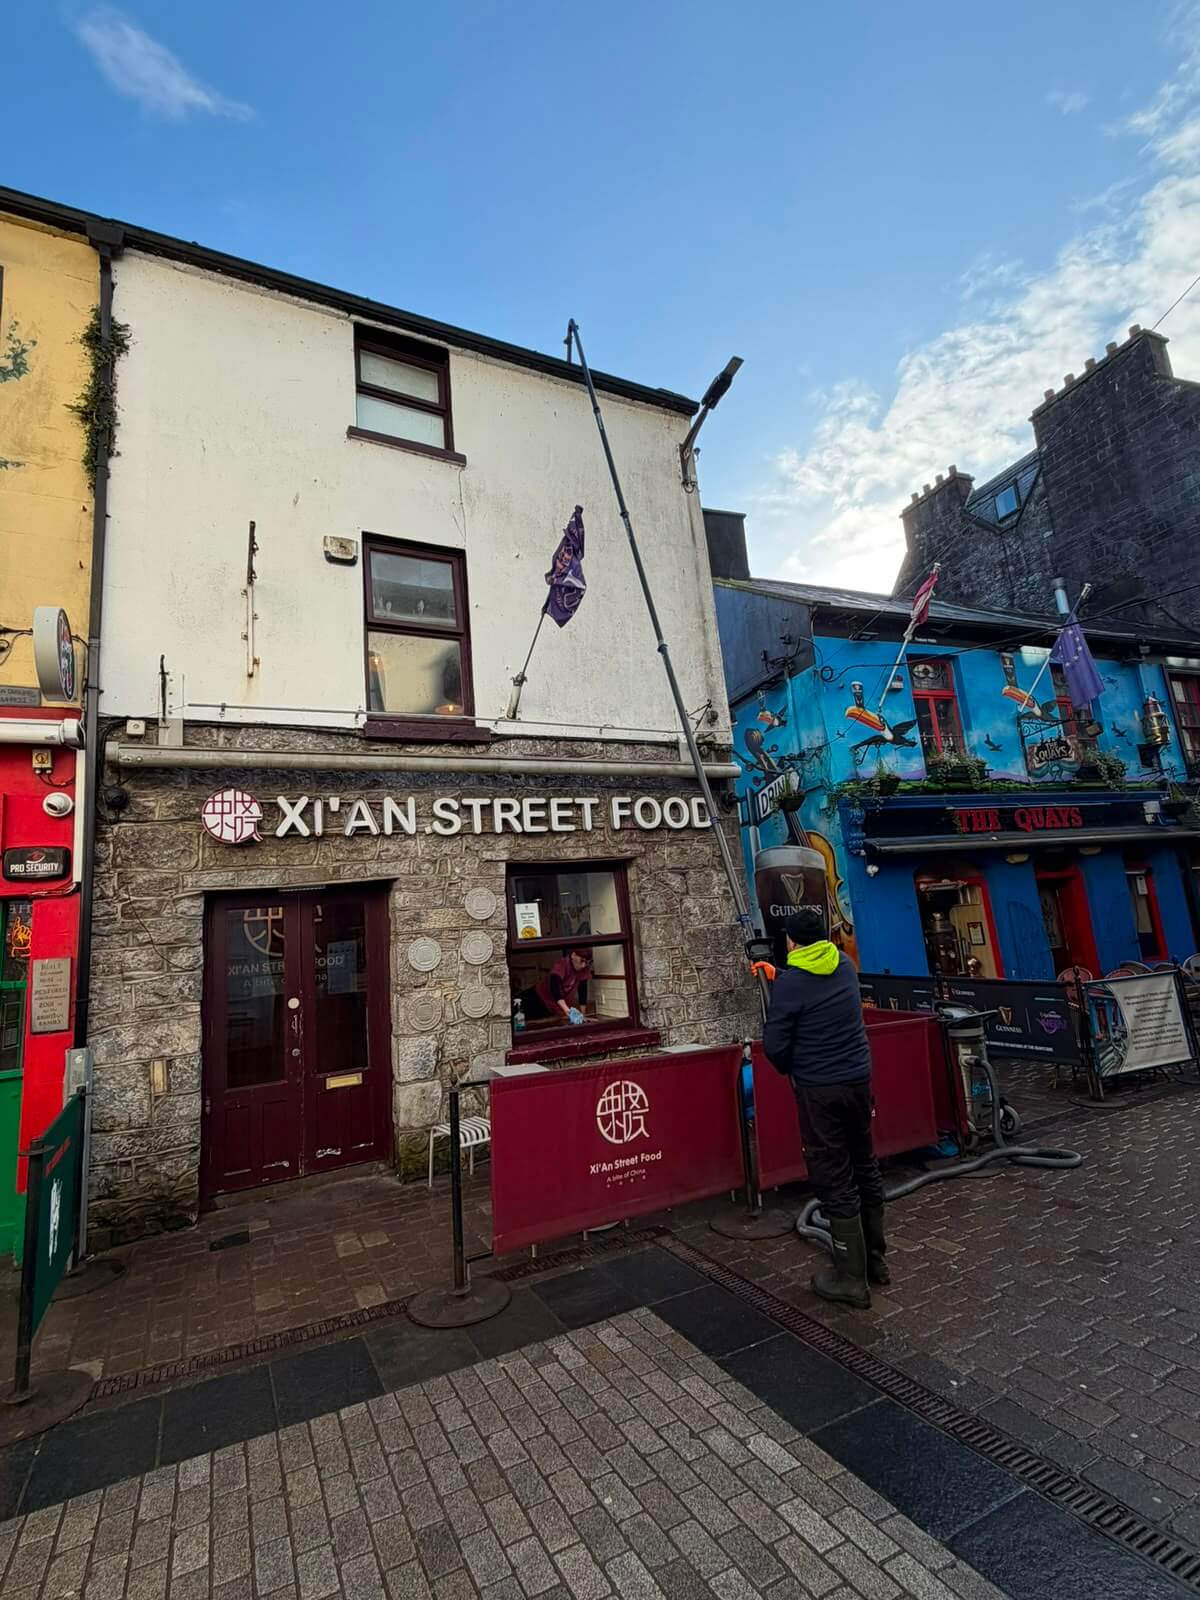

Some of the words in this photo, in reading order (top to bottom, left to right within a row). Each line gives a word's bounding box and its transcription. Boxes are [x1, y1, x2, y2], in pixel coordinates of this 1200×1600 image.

[1038, 744, 1069, 760] QUAYS
[1045, 740, 1058, 750] THE
[275, 795, 417, 837] XI'AN
[432, 797, 600, 836] STREET
[610, 796, 713, 831] FOOD
[954, 808, 1002, 833] THE
[1013, 806, 1083, 833] QUAYS
[9, 863, 25, 873] PRO
[25, 862, 59, 872] SECURITY
[261, 959, 286, 973] STR
[590, 1162, 614, 1176] Xi'An
[614, 1154, 639, 1170] Street
[640, 1150, 662, 1163] Food
